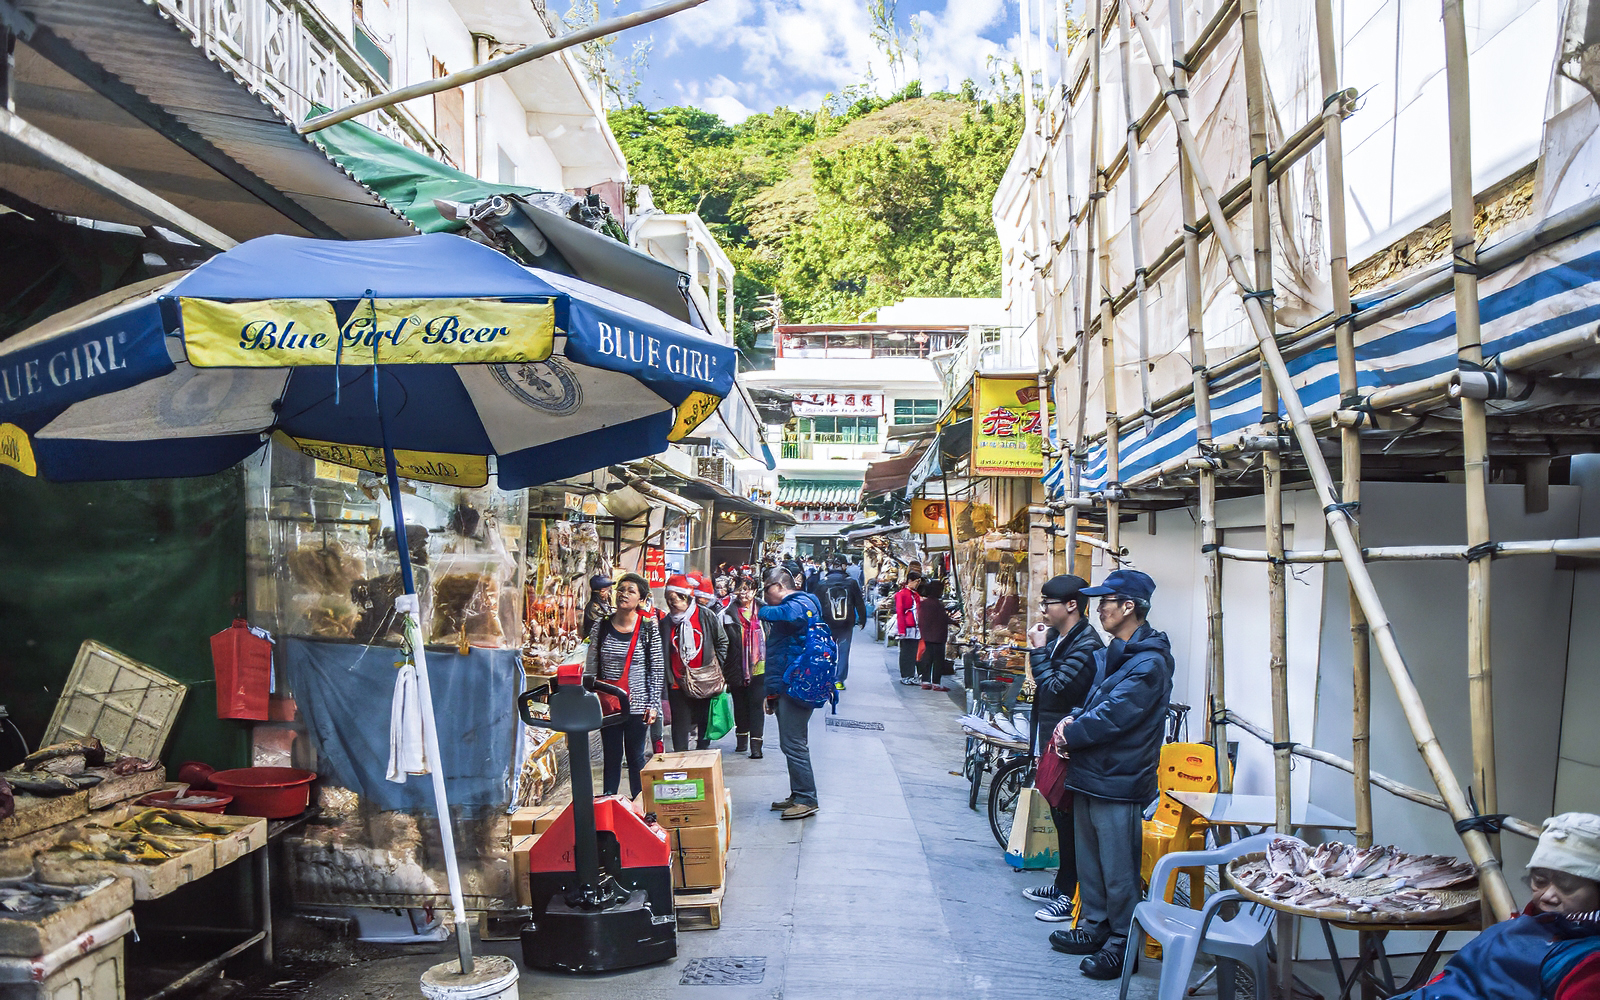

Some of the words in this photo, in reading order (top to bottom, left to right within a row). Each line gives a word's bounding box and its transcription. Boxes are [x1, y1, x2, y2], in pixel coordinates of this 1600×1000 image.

[239, 319, 331, 350] Blue
[342, 316, 406, 348] Girl
[422, 315, 511, 346] Beer
[598, 322, 661, 368] BLUE
[666, 344, 714, 382] GIRL
[0, 359, 42, 403] UE
[48, 336, 127, 386] GIRL
